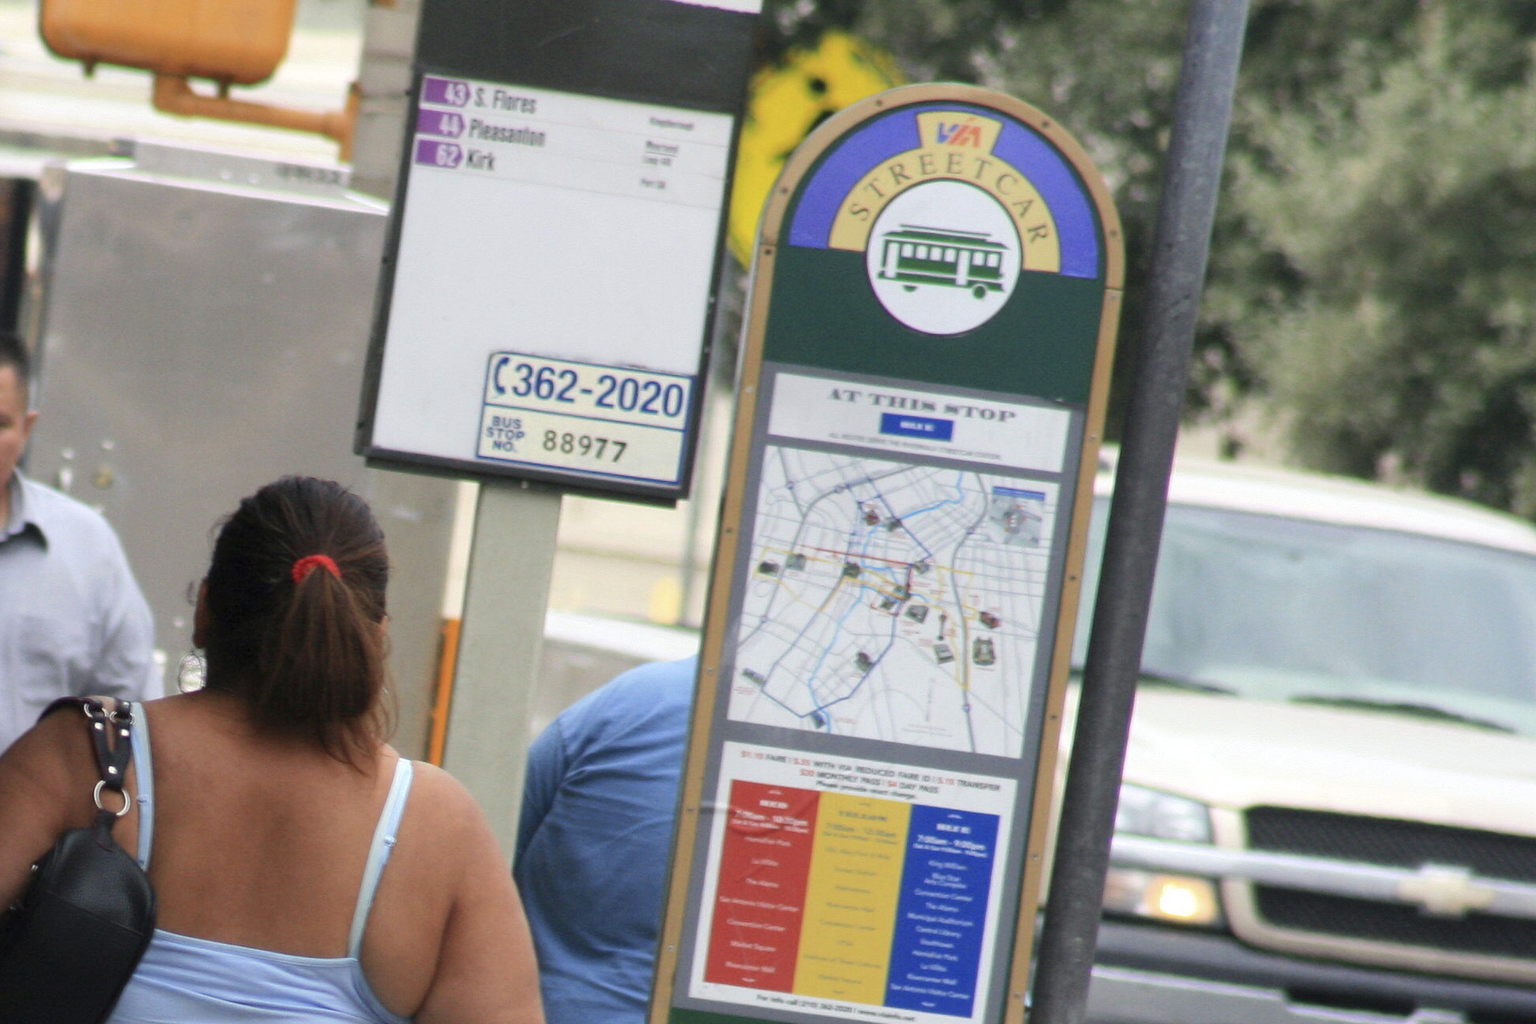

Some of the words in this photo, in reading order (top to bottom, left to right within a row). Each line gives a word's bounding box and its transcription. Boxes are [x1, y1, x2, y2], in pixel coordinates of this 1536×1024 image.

[444, 83, 466, 106] 43
[493, 90, 538, 114] Flores
[439, 114, 461, 136] 44
[469, 118, 547, 147] Pleasanton
[436, 144, 458, 167] 62
[466, 149, 496, 170] Kirk
[850, 152, 1049, 245] STREETCAR
[512, 363, 684, 418] 362-2020
[829, 388, 862, 402] AT
[869, 393, 937, 412] THIS
[944, 403, 1017, 422] STOP
[486, 426, 525, 442] STOP
[492, 415, 523, 430] BUS
[492, 440, 518, 453] NO.
[542, 430, 628, 463] 88977
